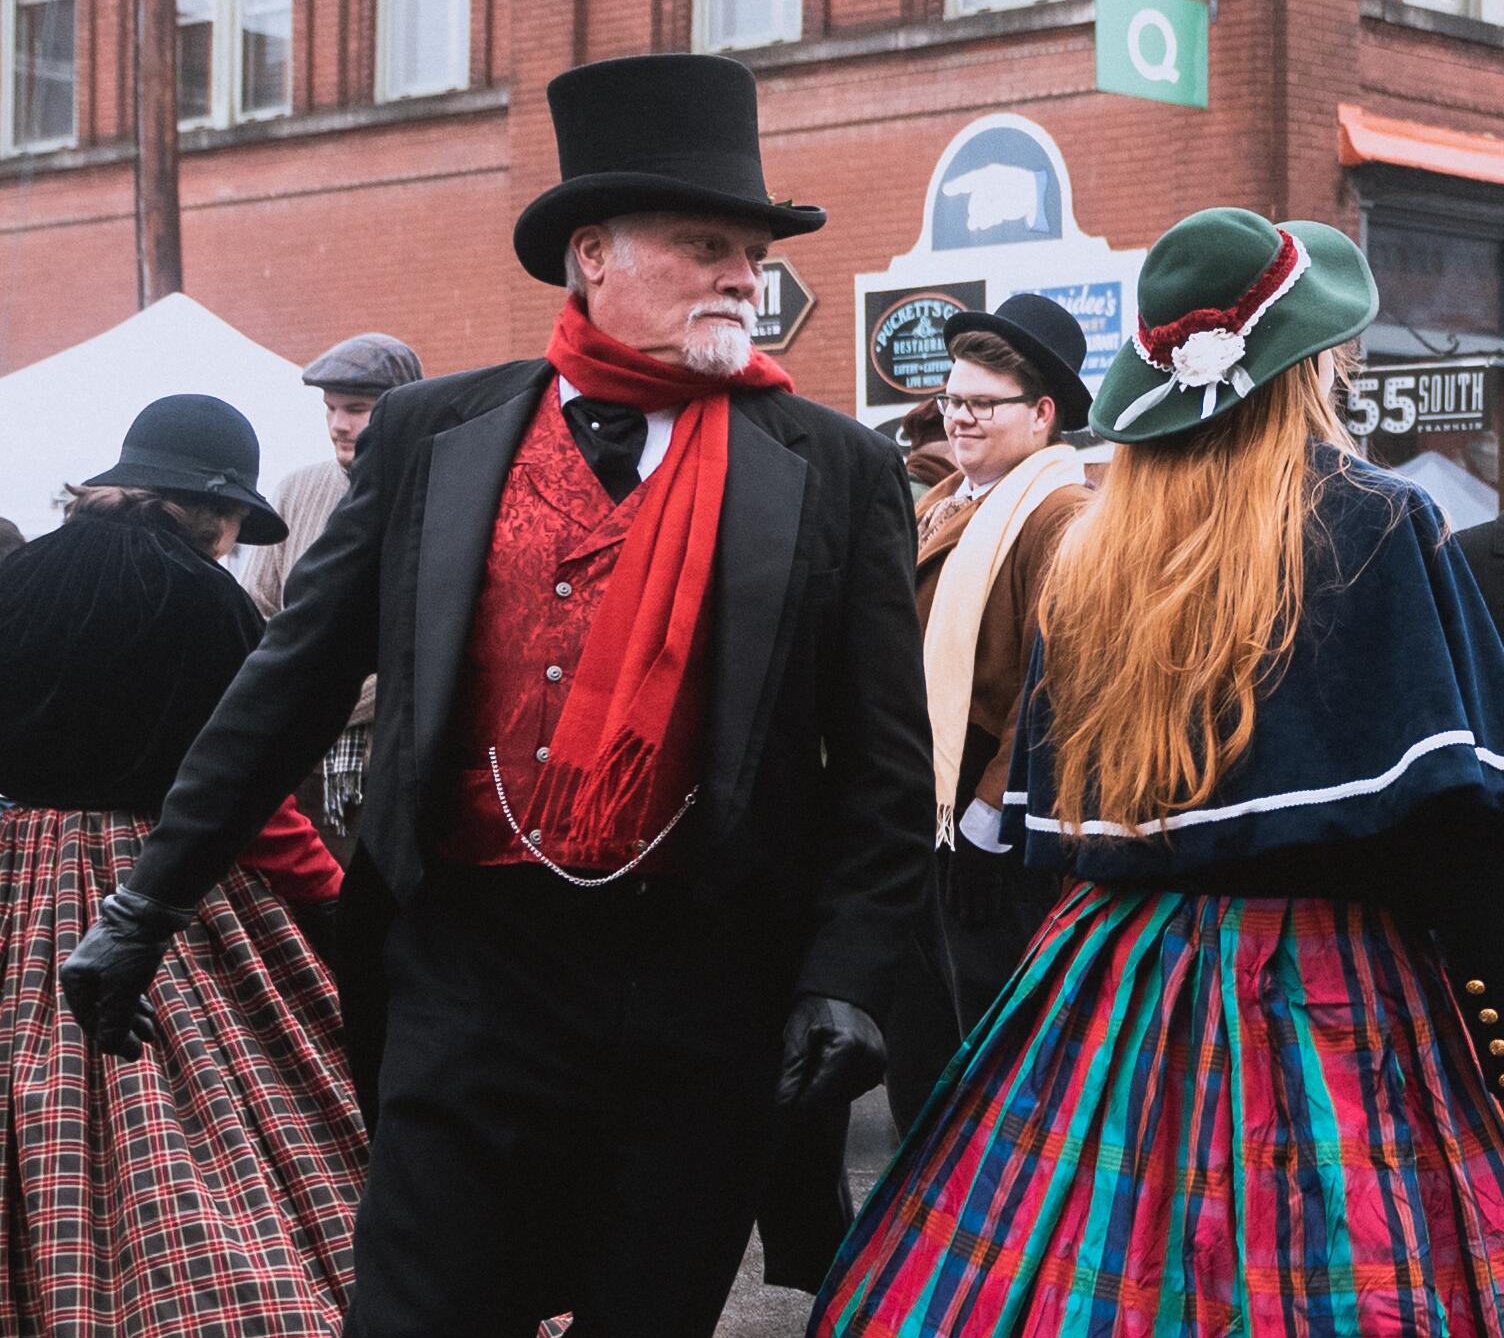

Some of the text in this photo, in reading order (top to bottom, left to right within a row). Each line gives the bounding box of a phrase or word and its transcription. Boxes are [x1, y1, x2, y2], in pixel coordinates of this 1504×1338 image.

[1127, 8, 1180, 84] Q
[1347, 372, 1485, 436] 55 SOUTH
